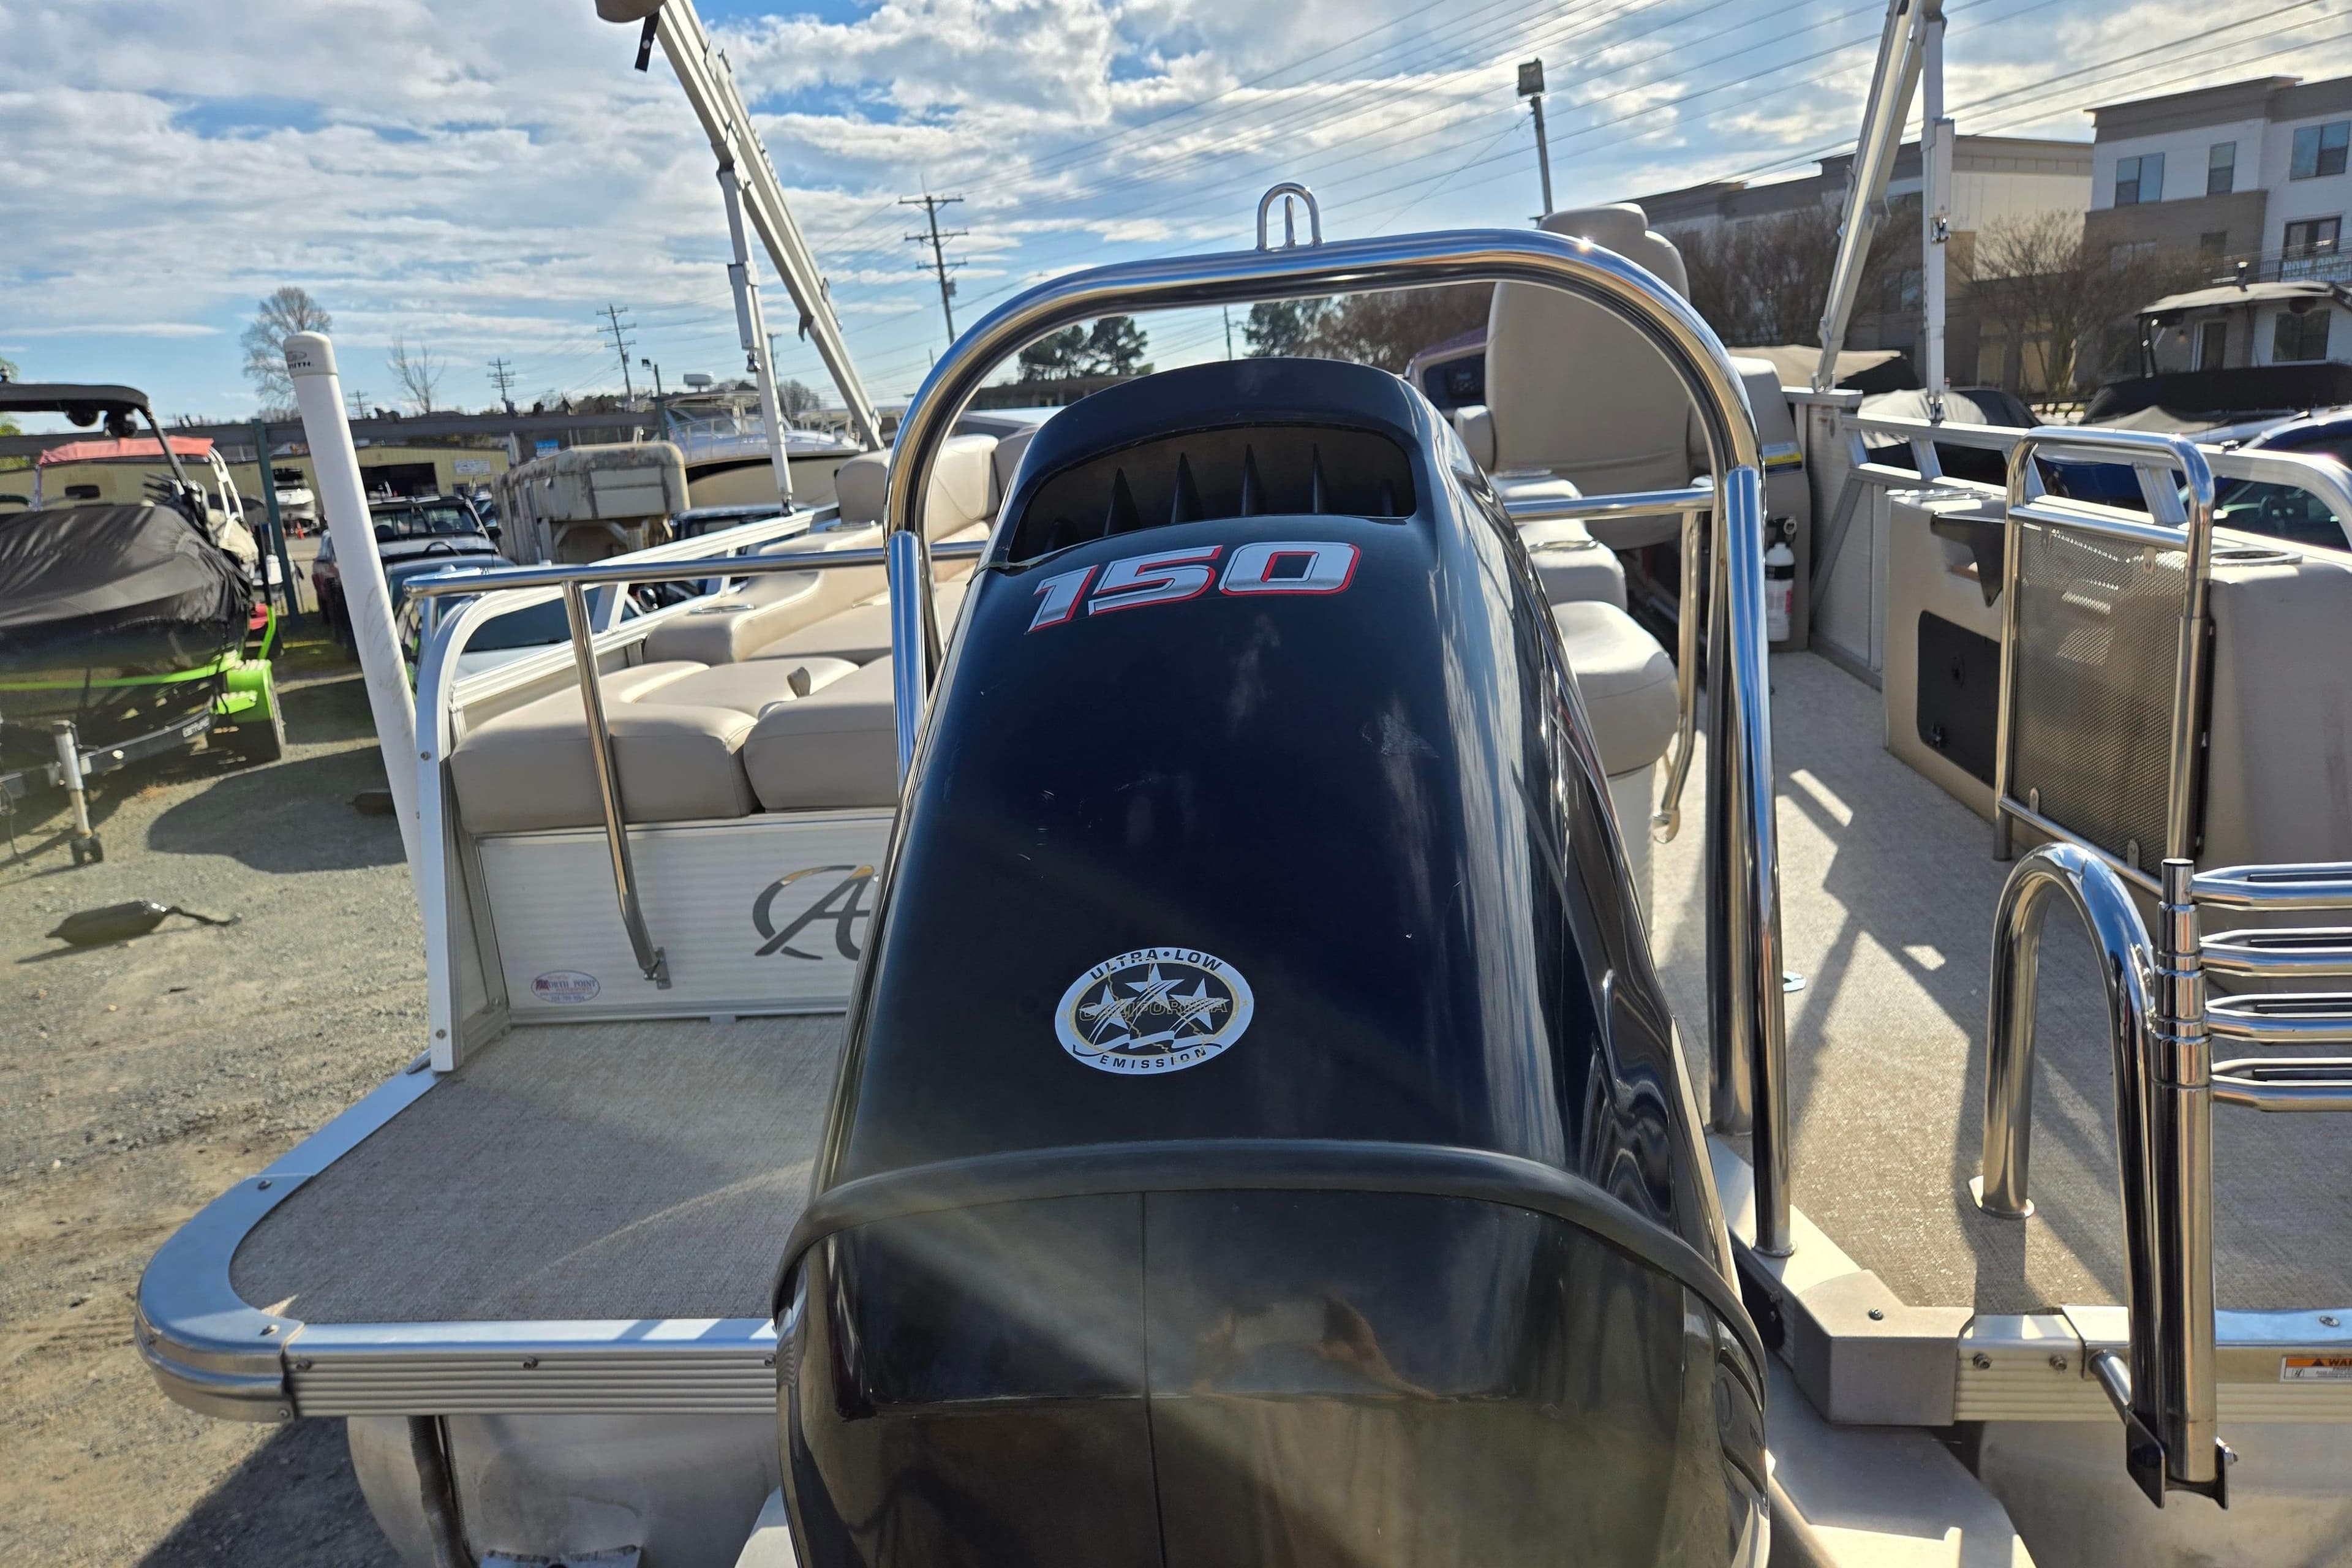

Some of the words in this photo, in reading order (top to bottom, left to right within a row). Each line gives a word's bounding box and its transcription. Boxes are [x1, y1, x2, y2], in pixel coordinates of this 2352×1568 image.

[1025, 541, 1361, 635] 150
[1090, 949, 1158, 980] ULTRA
[1174, 949, 1223, 971] LOW
[573, 979, 597, 989] POINT
[1099, 1047, 1207, 1069] EMISSION
